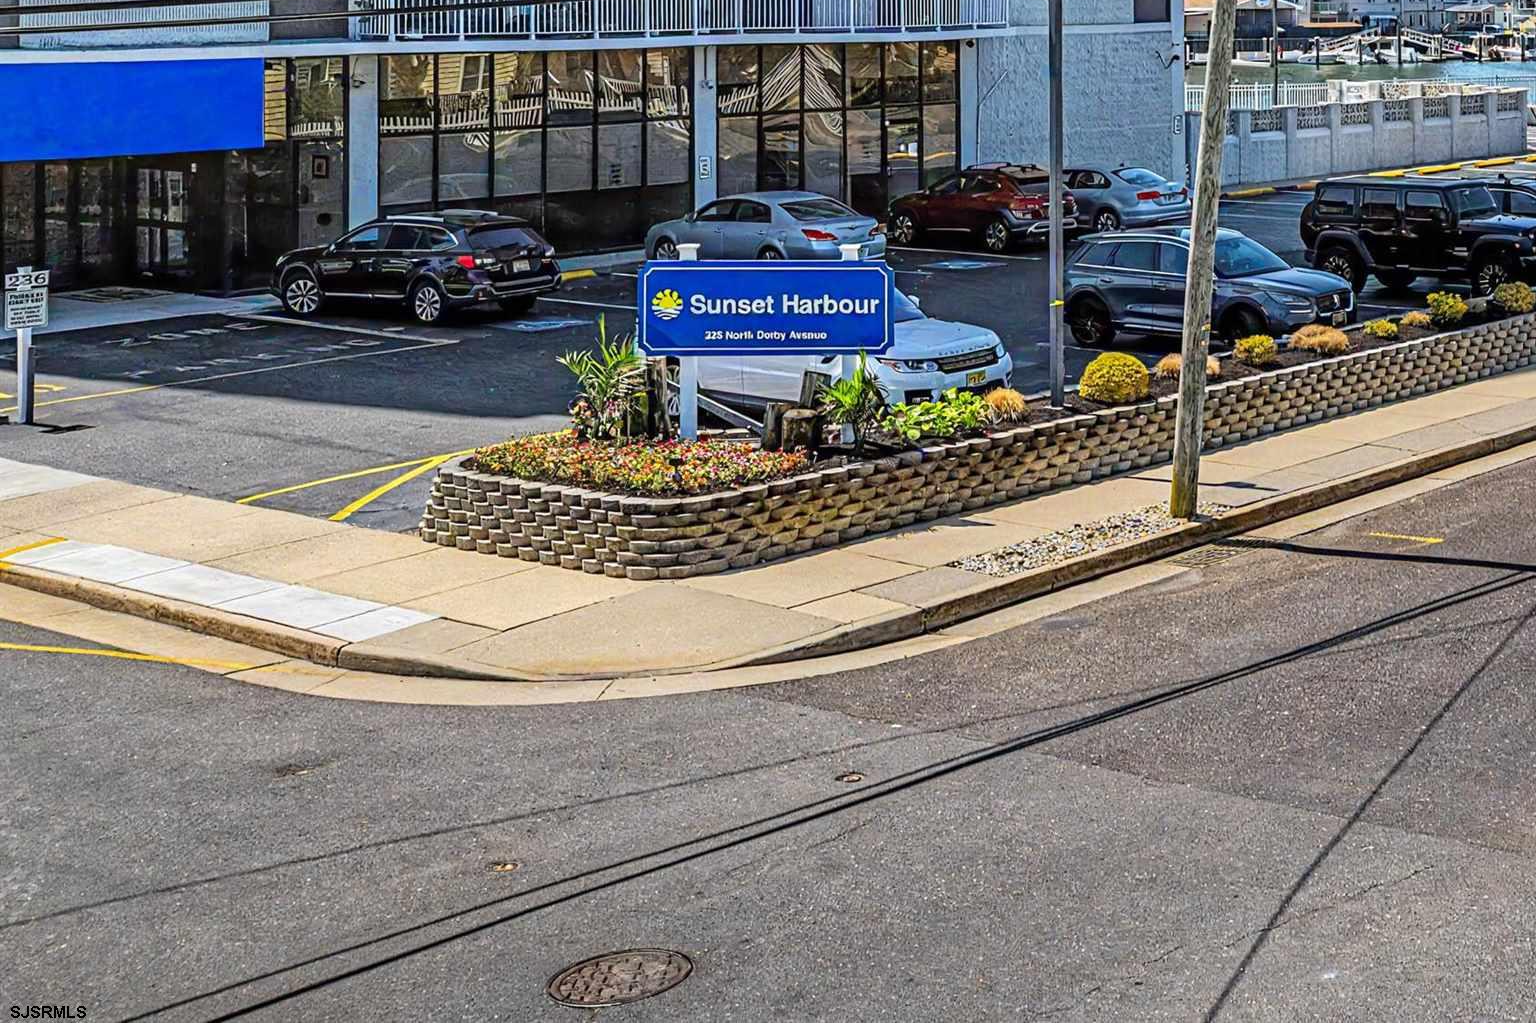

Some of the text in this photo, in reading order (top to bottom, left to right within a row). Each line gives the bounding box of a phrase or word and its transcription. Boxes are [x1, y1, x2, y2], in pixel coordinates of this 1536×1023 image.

[8, 273, 46, 287] 236
[690, 294, 880, 315] Sunset Harbour
